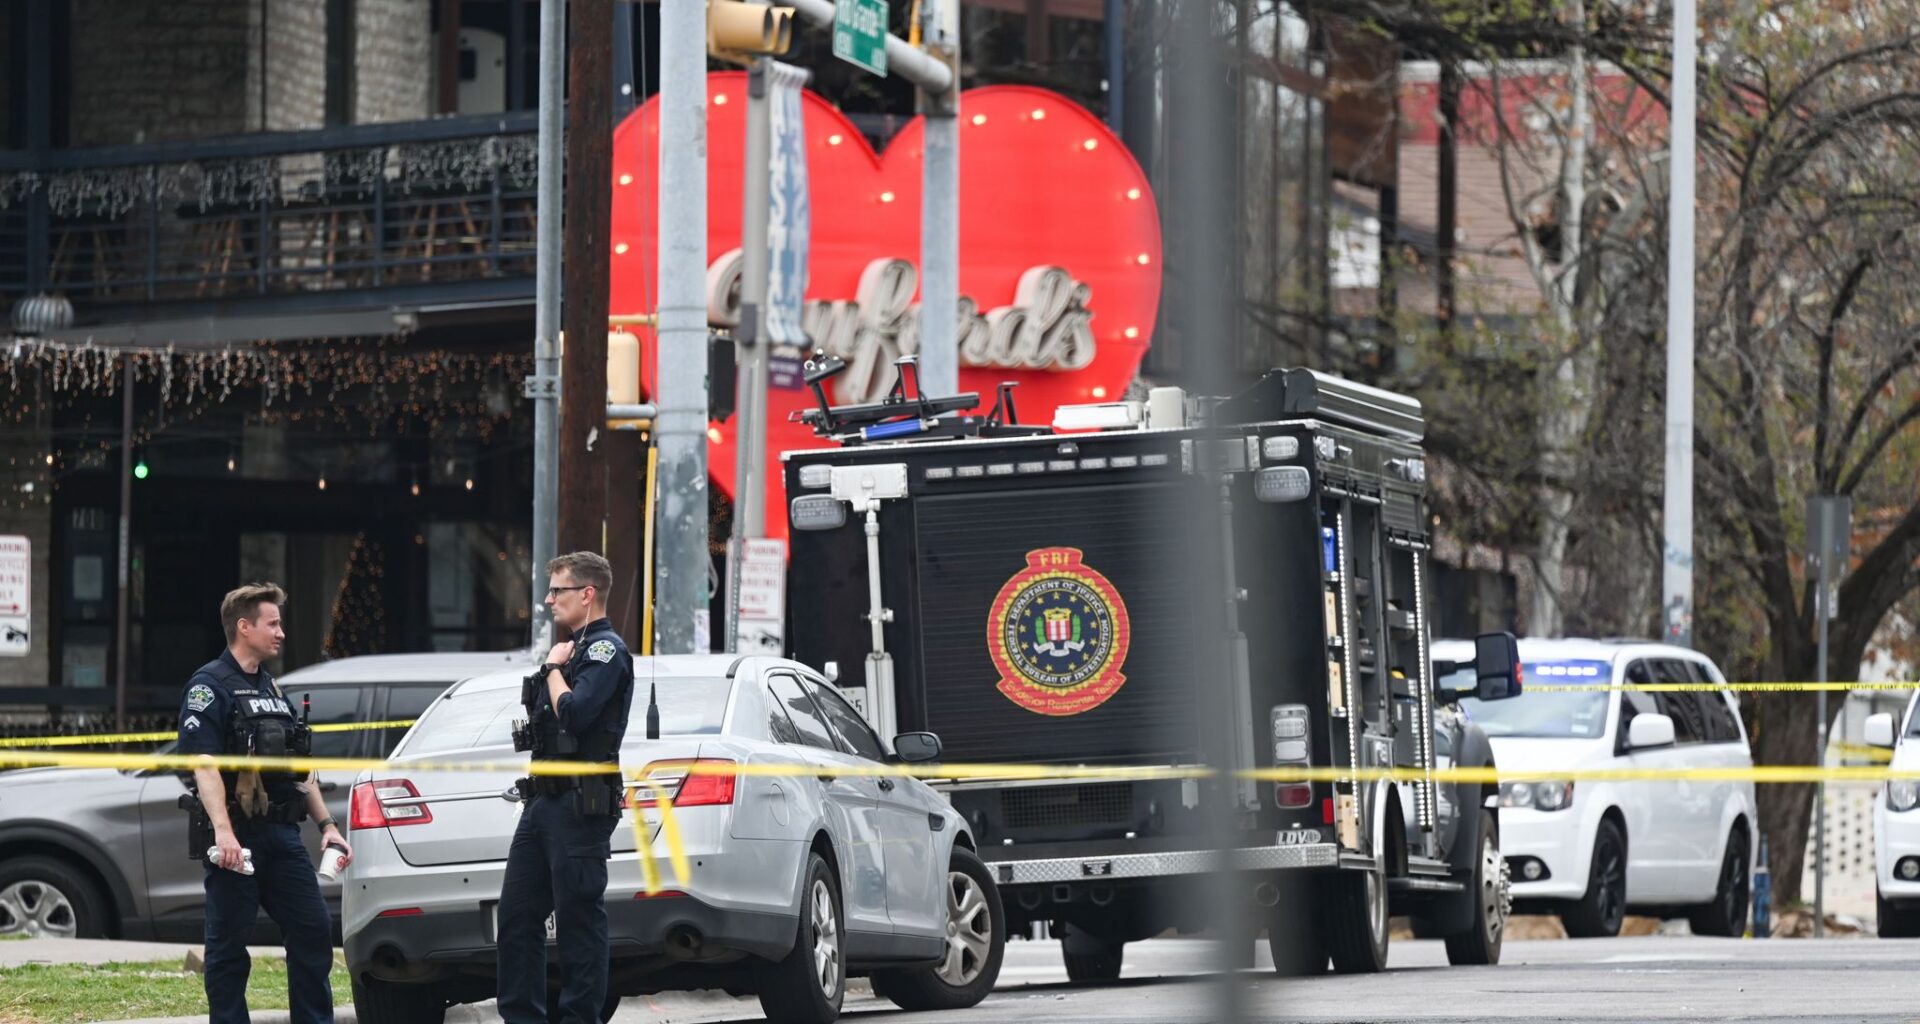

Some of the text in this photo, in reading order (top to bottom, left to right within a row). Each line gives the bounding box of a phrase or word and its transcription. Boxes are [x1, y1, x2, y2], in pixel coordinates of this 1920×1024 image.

[1040, 552, 1070, 567] FBI
[1010, 581, 1105, 620] DEPARTMENT OF JUSTICE
[1007, 619, 1109, 684] FEDERAL BUREAU OF INVESTIGATION
[1005, 676, 1119, 711] Evidence Response Team
[248, 698, 292, 717] POLIC
[1277, 831, 1307, 845] LDV
